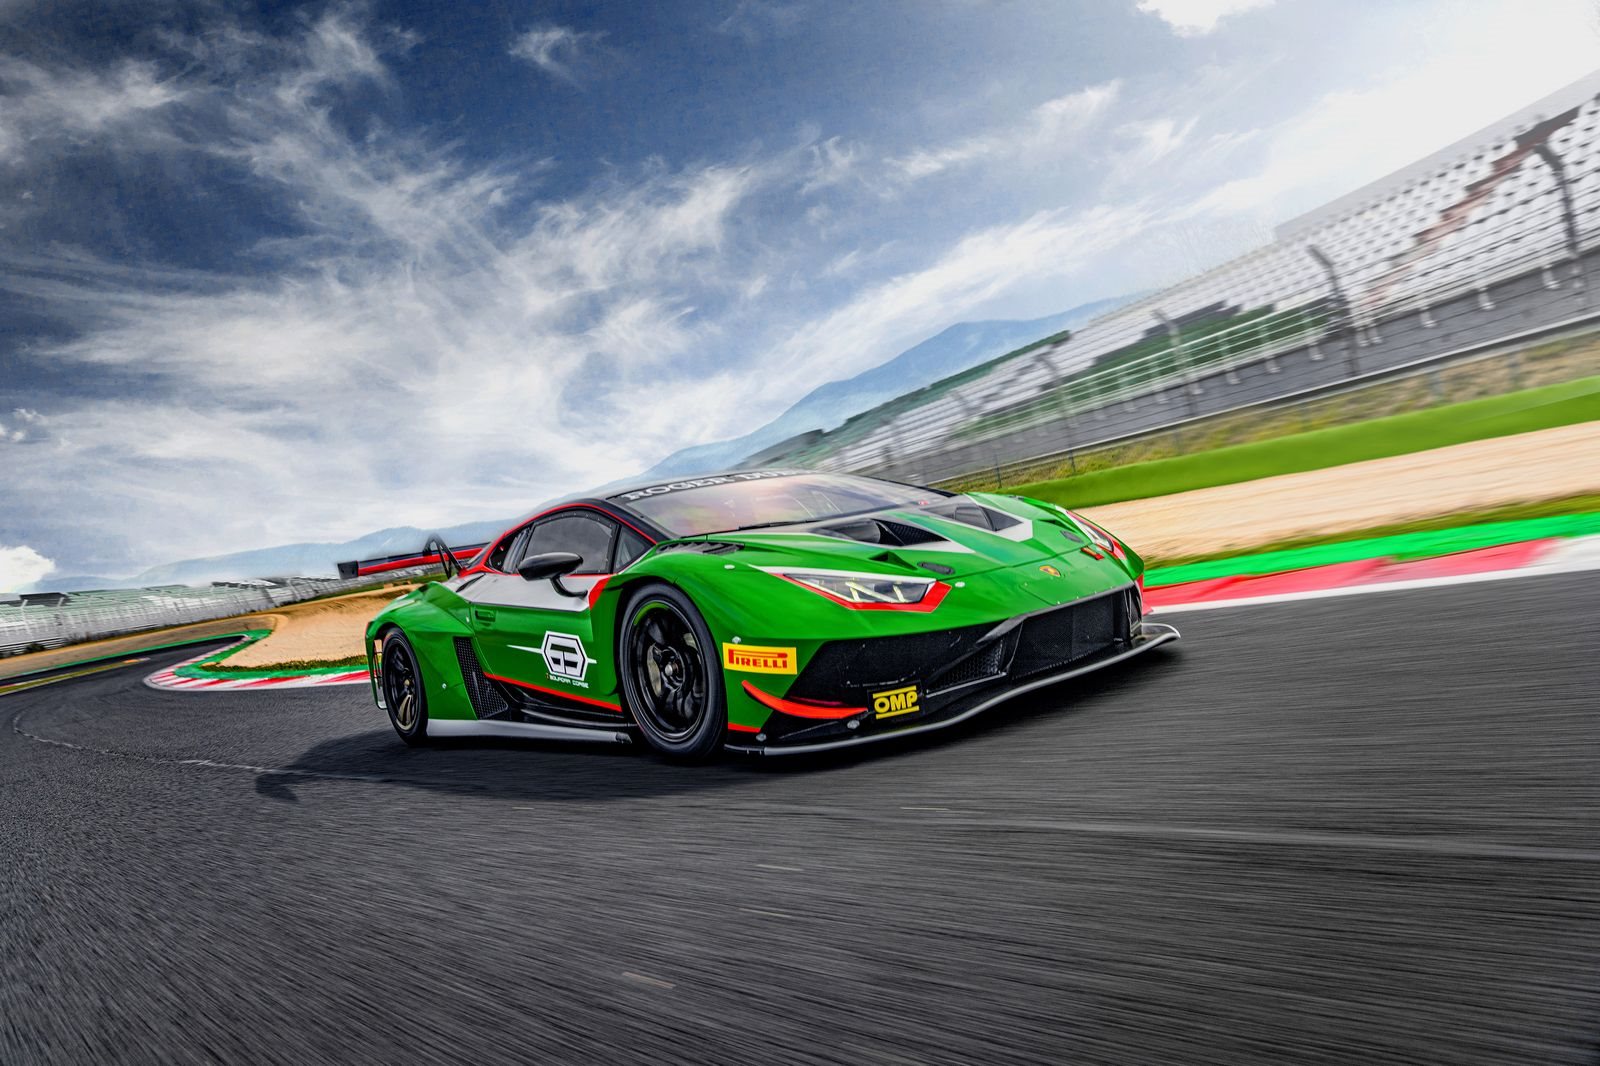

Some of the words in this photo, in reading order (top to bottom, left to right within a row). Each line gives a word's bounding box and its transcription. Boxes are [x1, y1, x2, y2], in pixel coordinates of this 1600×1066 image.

[621, 477, 735, 500] ROGER
[728, 648, 788, 669] PIRELLI
[874, 690, 918, 714] OMP
